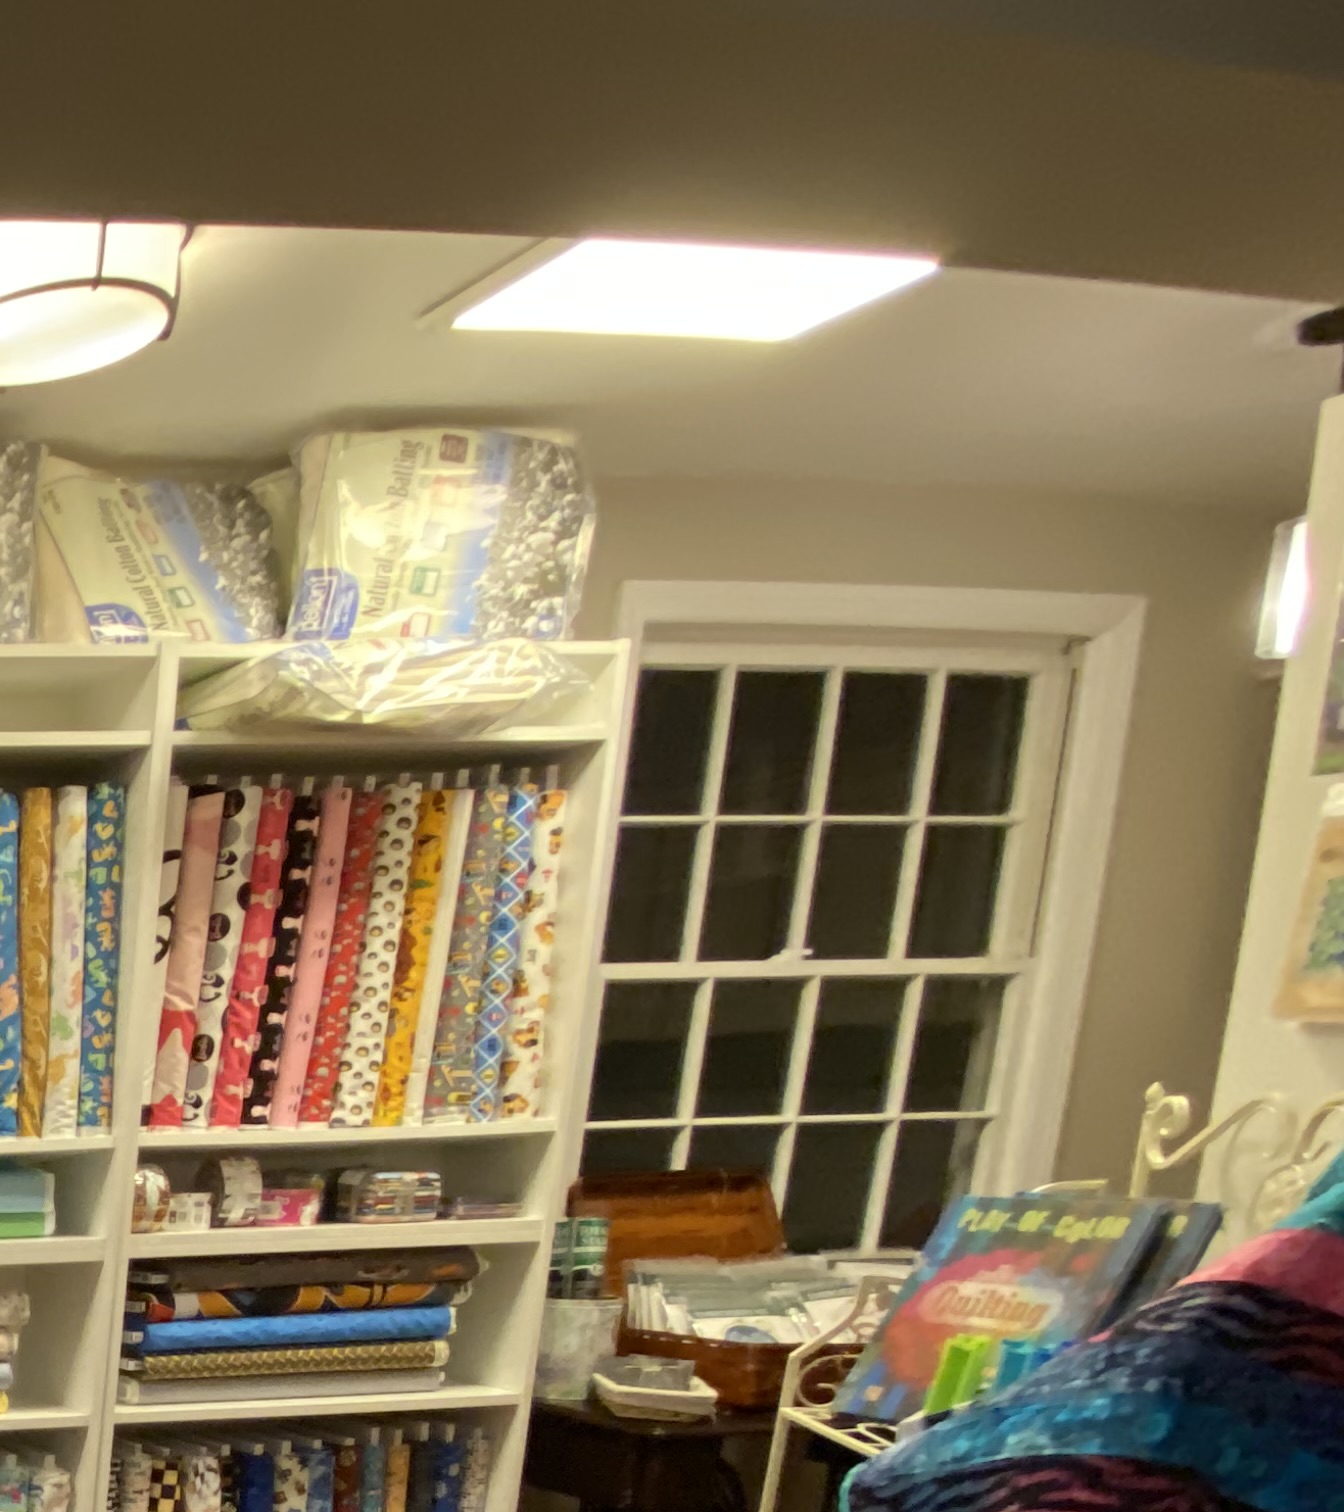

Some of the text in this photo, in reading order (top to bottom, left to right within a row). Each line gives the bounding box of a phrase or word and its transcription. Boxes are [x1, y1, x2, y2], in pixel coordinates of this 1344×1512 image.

[386, 438, 424, 498] Batting
[132, 585, 170, 631] Natural
[362, 557, 394, 618] Natural
[935, 1281, 1054, 1327] Quilting
